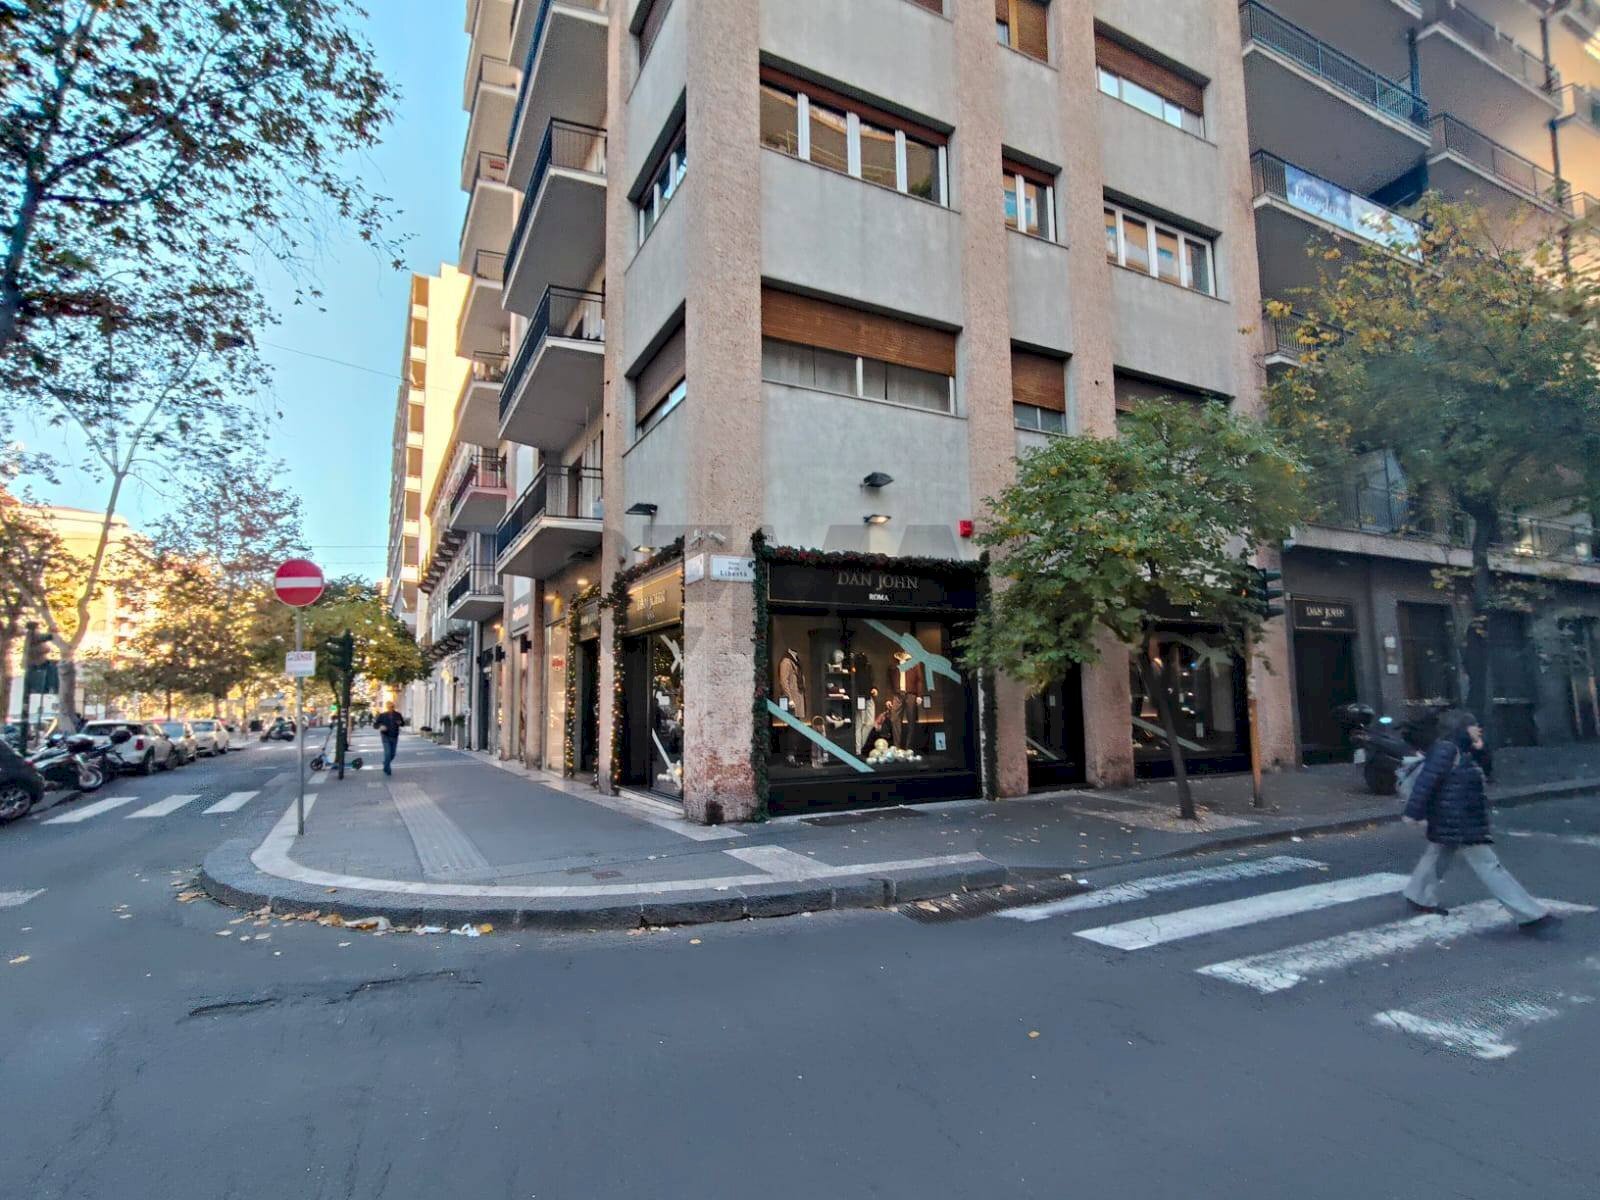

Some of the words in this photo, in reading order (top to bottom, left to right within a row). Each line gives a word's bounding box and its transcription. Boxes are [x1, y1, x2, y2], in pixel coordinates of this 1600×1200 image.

[837, 572, 871, 587] DAN
[876, 573, 919, 591] JOHN
[868, 593, 889, 601] ROMA
